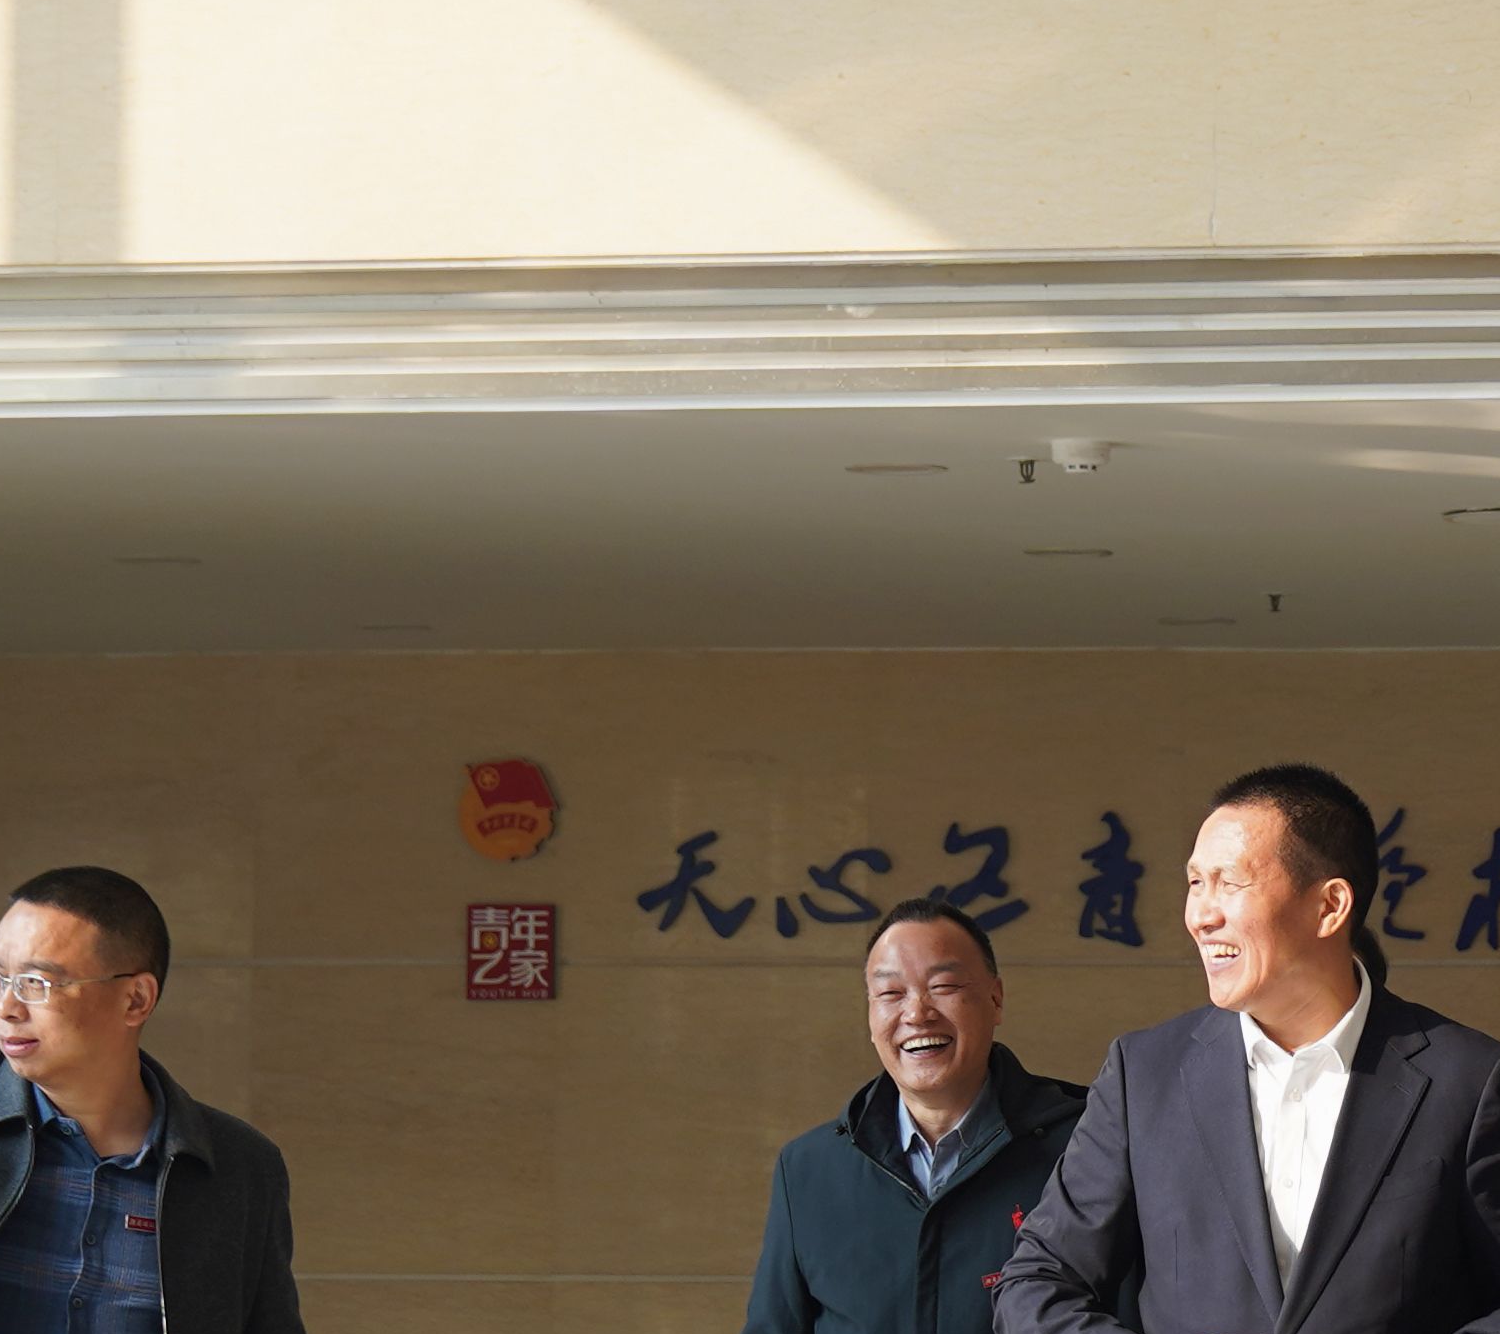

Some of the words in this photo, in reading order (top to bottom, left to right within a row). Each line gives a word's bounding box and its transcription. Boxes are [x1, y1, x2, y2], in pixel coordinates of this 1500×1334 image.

[470, 907, 549, 950] 青年
[469, 989, 517, 999] YOUTH
[523, 989, 549, 999] HUB
